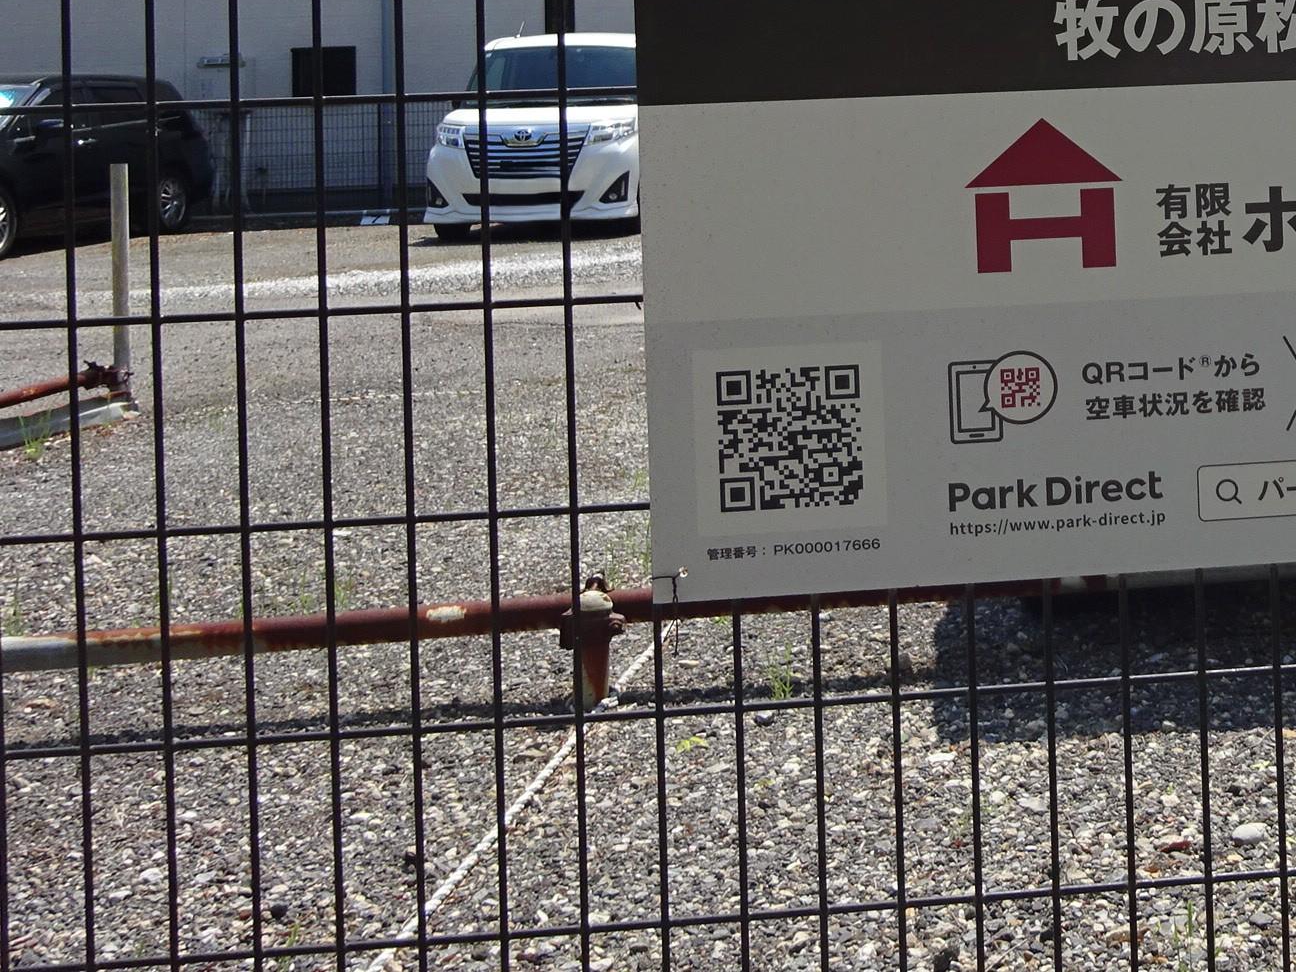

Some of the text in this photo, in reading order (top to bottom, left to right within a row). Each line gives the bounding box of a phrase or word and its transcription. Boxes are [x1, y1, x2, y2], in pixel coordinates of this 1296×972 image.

[1156, 182, 1231, 219] 有限
[1157, 220, 1232, 257] 会社
[1086, 388, 1265, 420] 空車状況を確認
[949, 471, 1163, 512] Park Direct
[950, 510, 1165, 536] https://www.park-direct.jp
[774, 539, 880, 555] PK000017666
